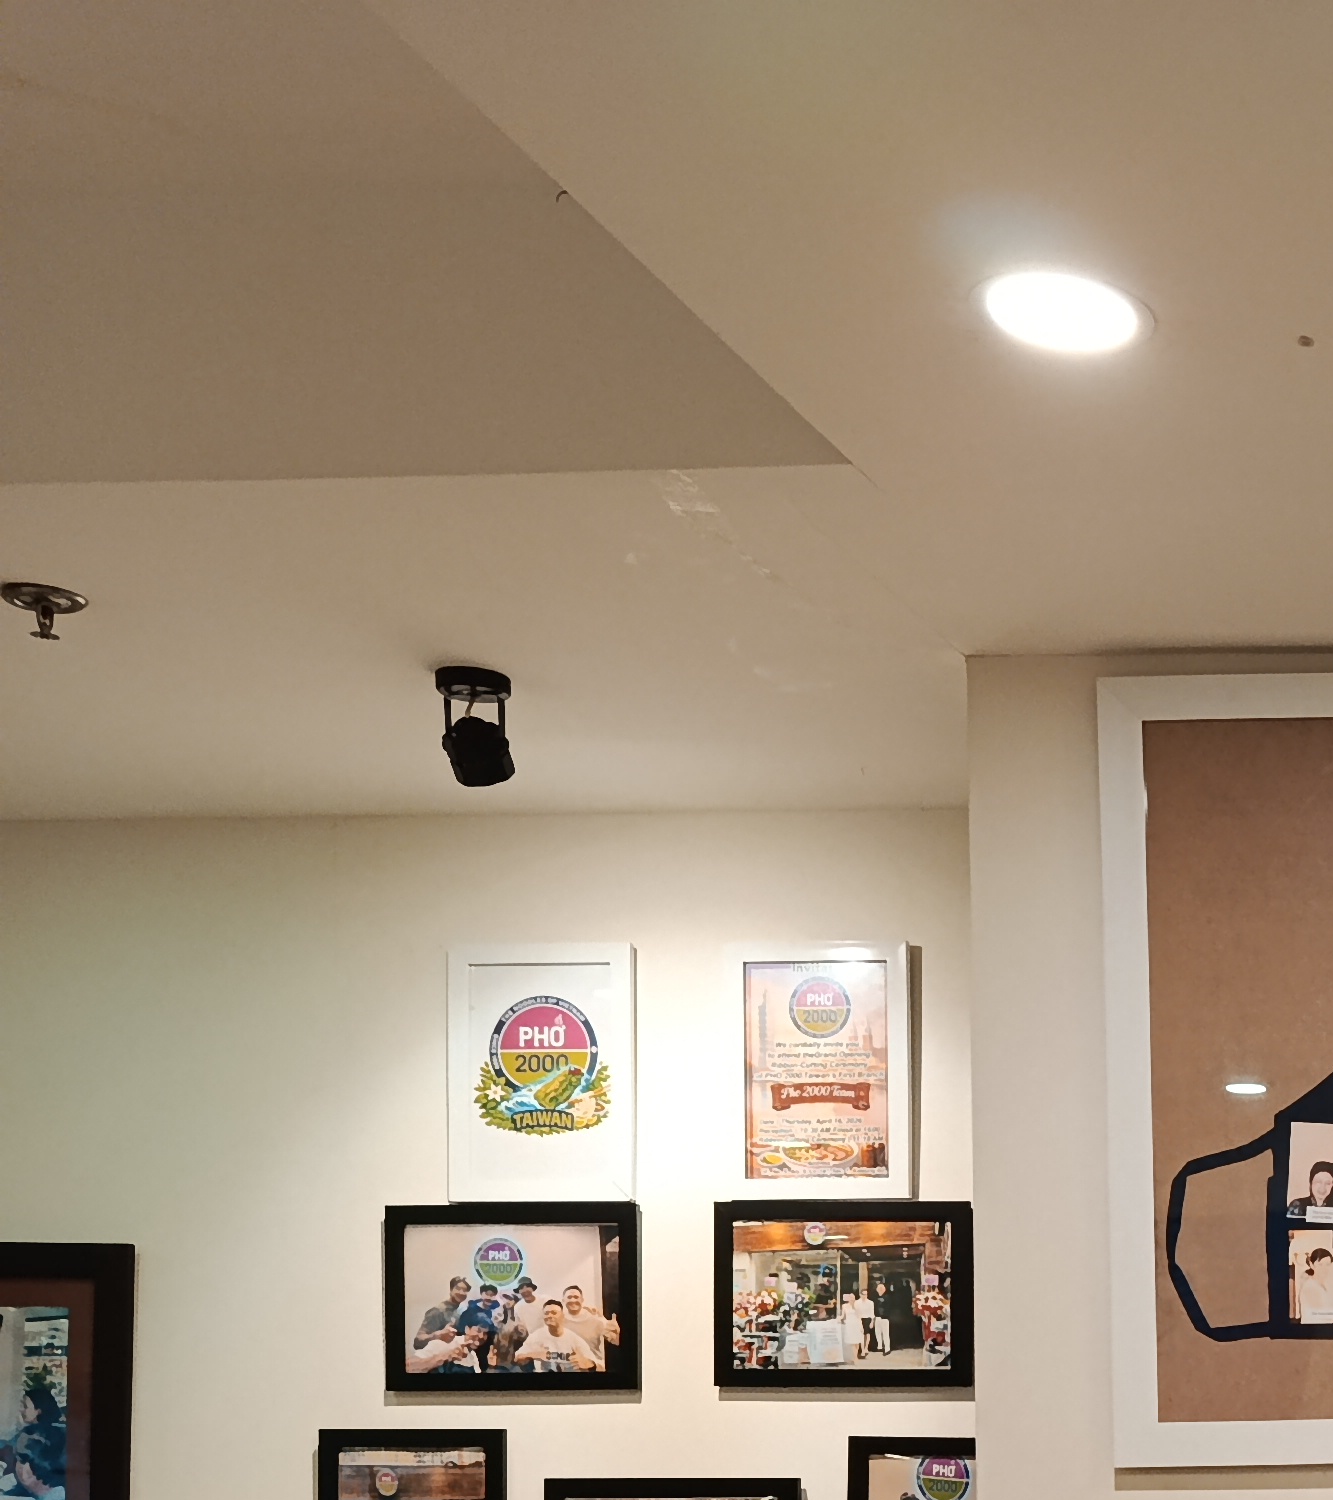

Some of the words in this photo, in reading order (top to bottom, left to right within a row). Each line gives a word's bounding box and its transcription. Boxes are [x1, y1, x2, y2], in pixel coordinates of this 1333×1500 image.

[803, 1010, 838, 1023] 2000
[515, 1054, 569, 1072] 2000
[802, 1086, 830, 1097] 2000
[514, 1111, 572, 1128] TAIWAN
[929, 1480, 957, 1493] 2000
